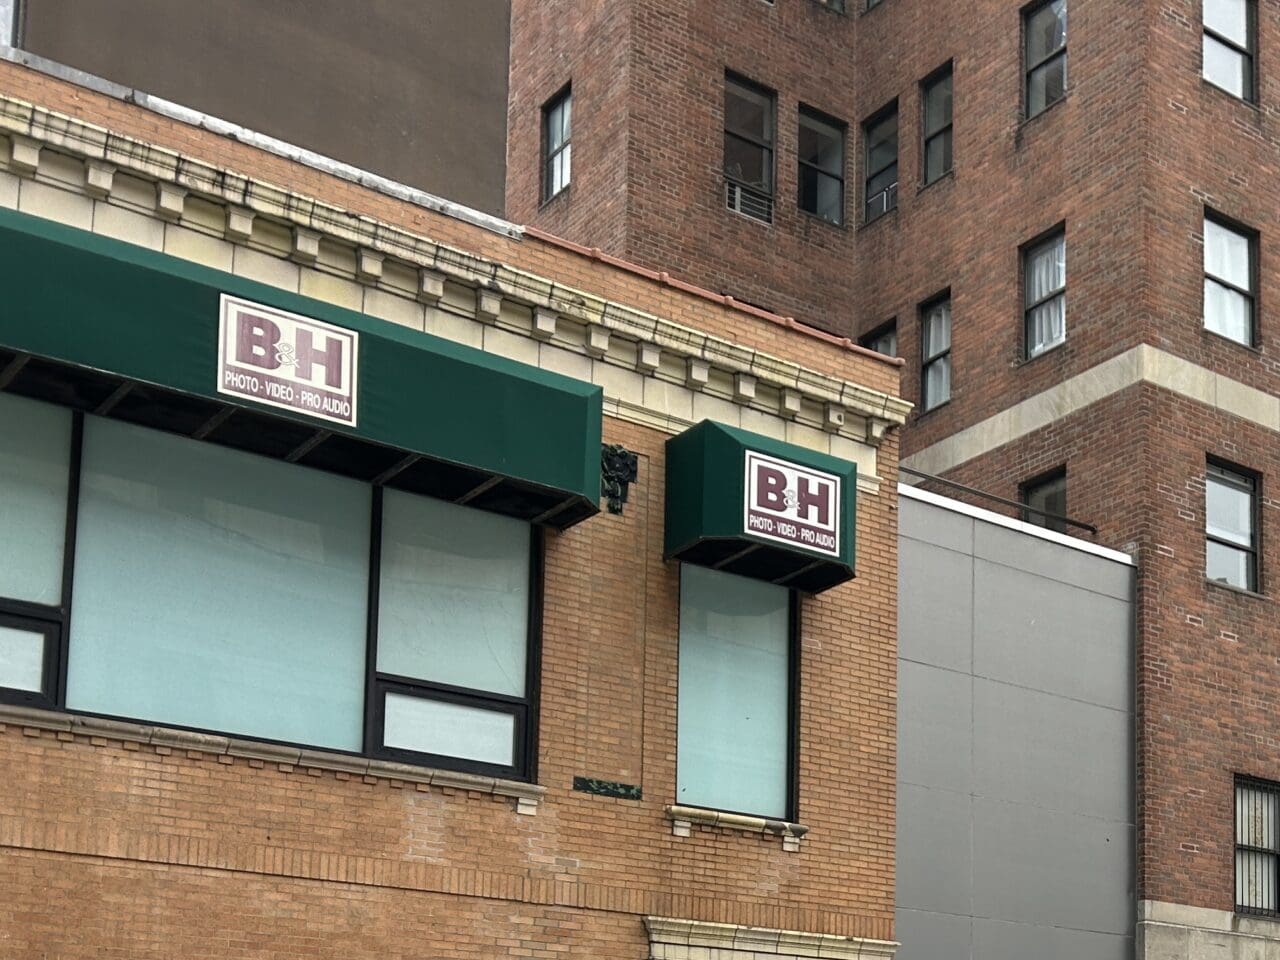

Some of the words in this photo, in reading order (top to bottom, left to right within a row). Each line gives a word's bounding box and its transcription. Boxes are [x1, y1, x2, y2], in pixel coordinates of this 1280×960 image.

[235, 310, 343, 390] B&H
[224, 370, 260, 393] PHOTO
[264, 380, 294, 401] VIDEO
[301, 390, 321, 409] PRO
[322, 397, 351, 417] AUDIO
[757, 464, 829, 526] B&H
[749, 514, 773, 532] PHOTO
[777, 521, 797, 538] VIDEO
[801, 527, 815, 543] PRO
[815, 532, 835, 549] AUDIO
